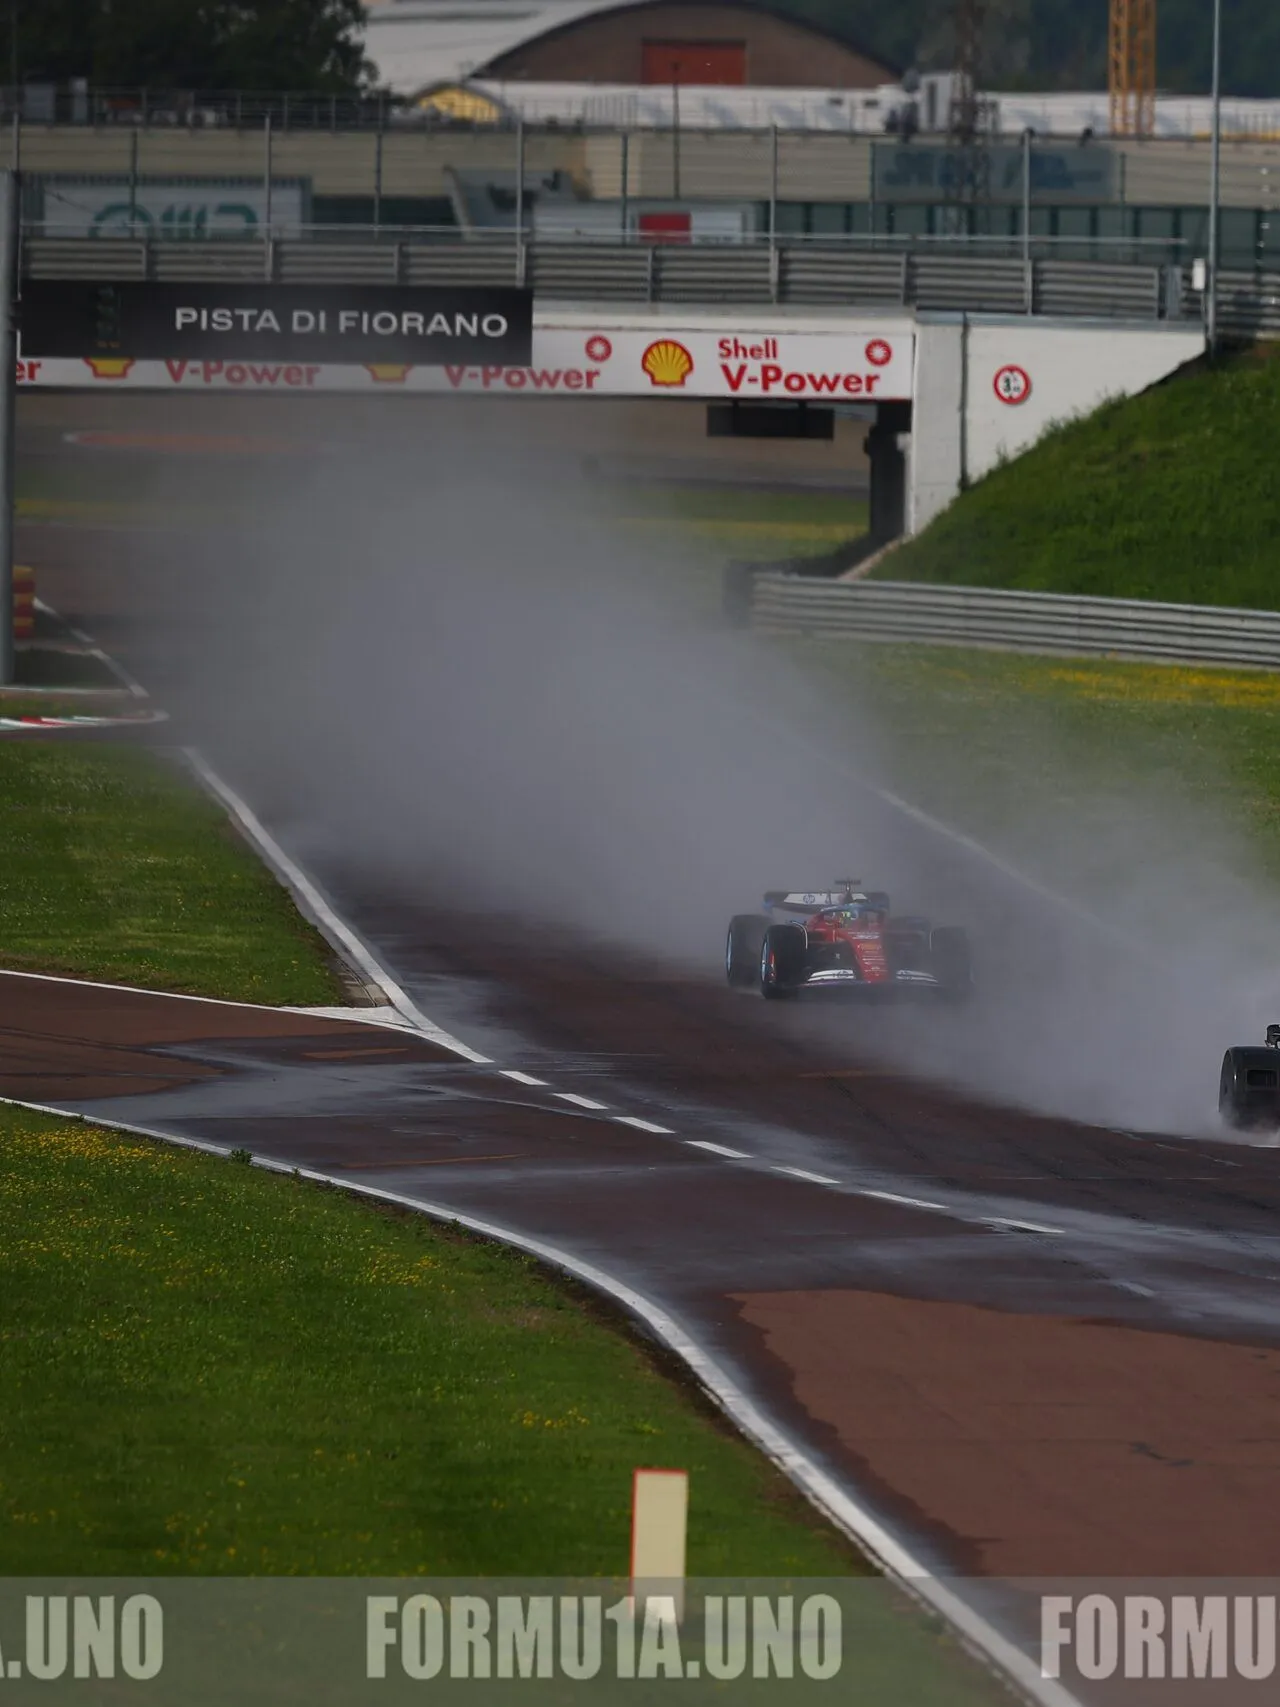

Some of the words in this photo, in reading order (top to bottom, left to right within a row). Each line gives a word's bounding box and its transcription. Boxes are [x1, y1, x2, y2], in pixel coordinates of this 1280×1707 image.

[175, 307, 281, 331] PISTA
[292, 310, 325, 333] DI
[339, 311, 508, 337] FIORANO
[718, 338, 777, 360] Shell
[165, 359, 322, 386] V-Power
[444, 365, 601, 389] V-Power
[719, 364, 882, 393] V-Power
